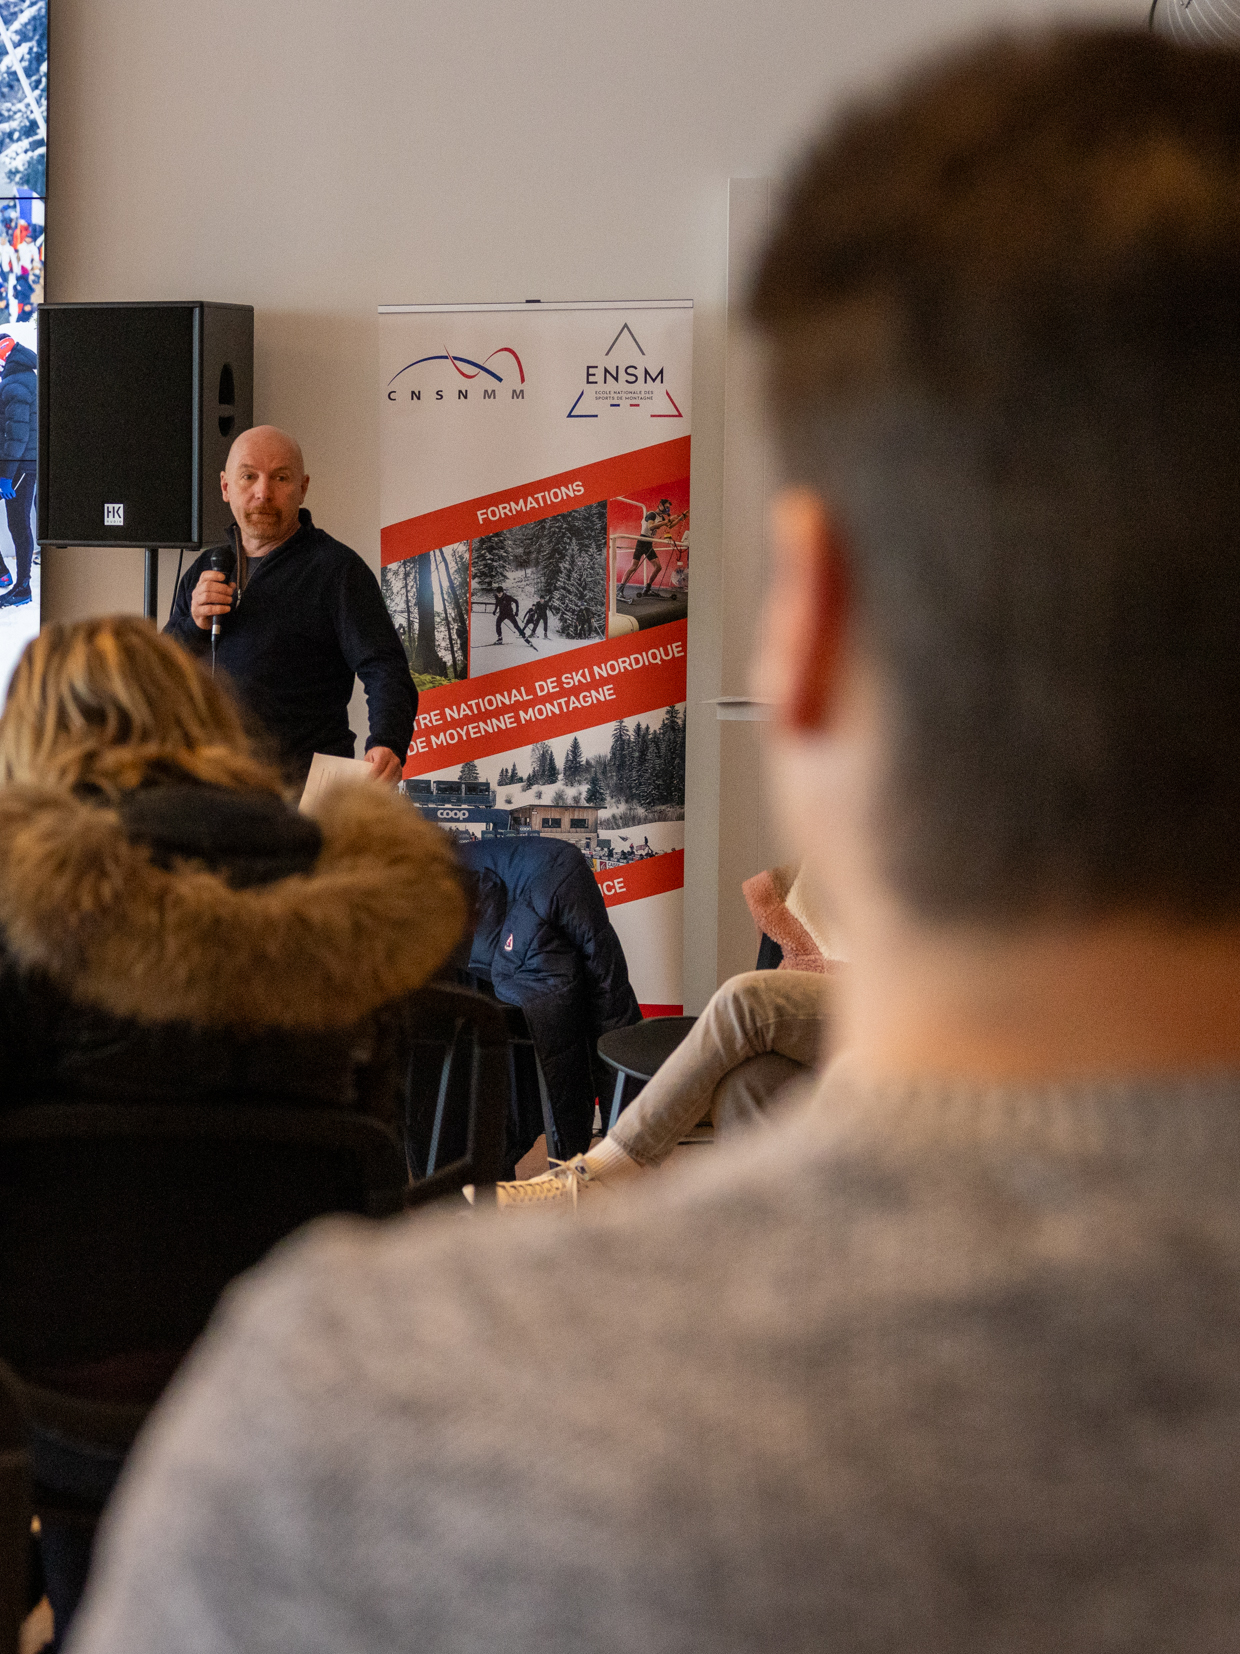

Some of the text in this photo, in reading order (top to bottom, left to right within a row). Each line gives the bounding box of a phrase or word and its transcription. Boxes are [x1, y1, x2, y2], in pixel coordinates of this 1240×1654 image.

[586, 365, 664, 385] ENSM
[106, 506, 122, 519] HK
[476, 480, 585, 525] FORMATIONS
[444, 686, 534, 722] NATIONAL
[534, 676, 560, 697] DE
[562, 668, 591, 689] SKI
[592, 641, 685, 680] NORDIQUE
[407, 684, 617, 756] DE MOYENNE MONTAGNE
[437, 809, 469, 821] coop
